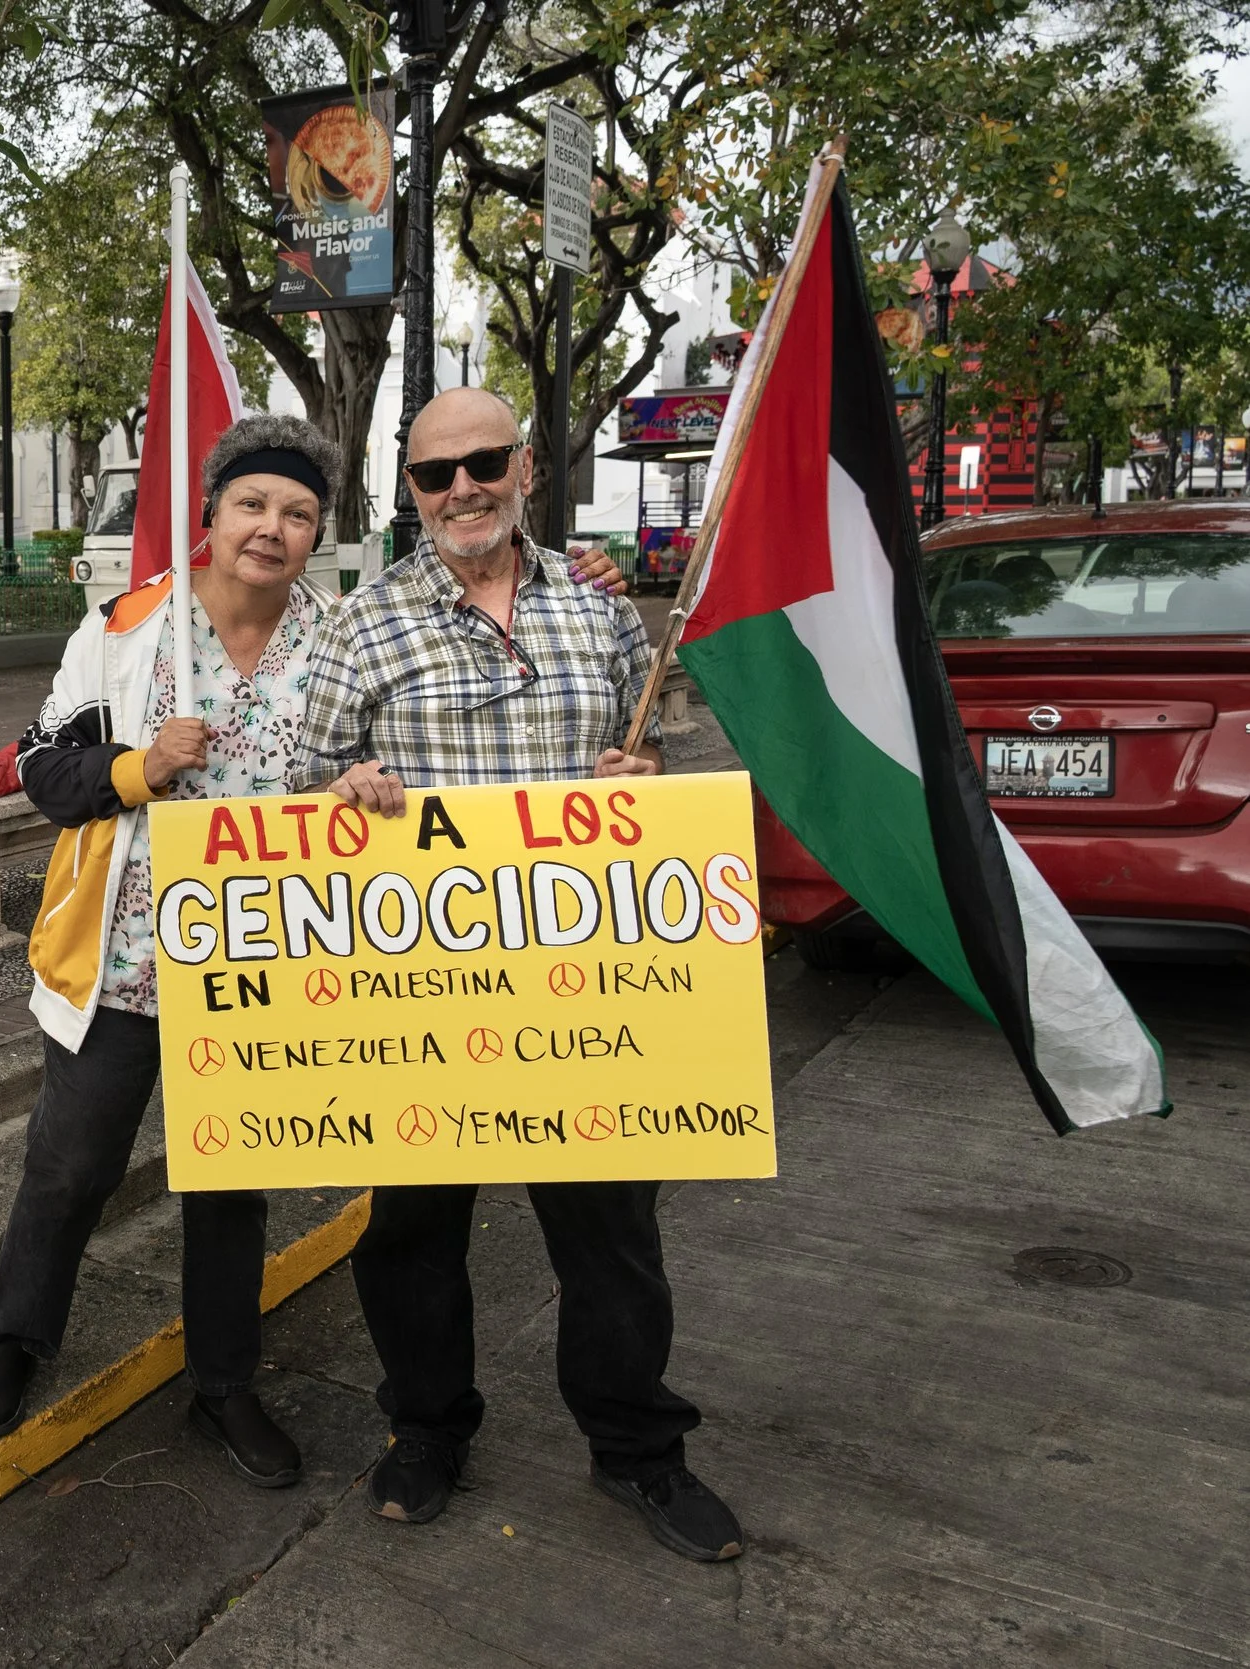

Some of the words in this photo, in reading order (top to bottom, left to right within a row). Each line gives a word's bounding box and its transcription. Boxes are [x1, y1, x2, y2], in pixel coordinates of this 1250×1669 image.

[554, 144, 589, 175] RESERVADO
[282, 212, 311, 222] PONCE
[292, 215, 349, 240] Music
[352, 208, 388, 232] and
[315, 236, 373, 257] Flavor
[651, 418, 682, 429] NEXT
[683, 416, 715, 427] LEVEL
[992, 749, 1037, 776] JEA
[1056, 749, 1103, 777] 454
[204, 803, 370, 864] ALTO
[417, 796, 466, 850] A
[515, 790, 642, 849] LOS
[158, 853, 761, 964] GENOCIDIOS
[203, 970, 272, 1011] EN
[351, 962, 516, 999] PALESTINA
[597, 955, 694, 994] IRÁN
[232, 1032, 447, 1071] VENEZUELA
[514, 1024, 644, 1062] CUBA
[242, 1097, 375, 1148] SUDÁN
[441, 1108, 567, 1148] YEMEN
[619, 1102, 770, 1144] ECUADOR
